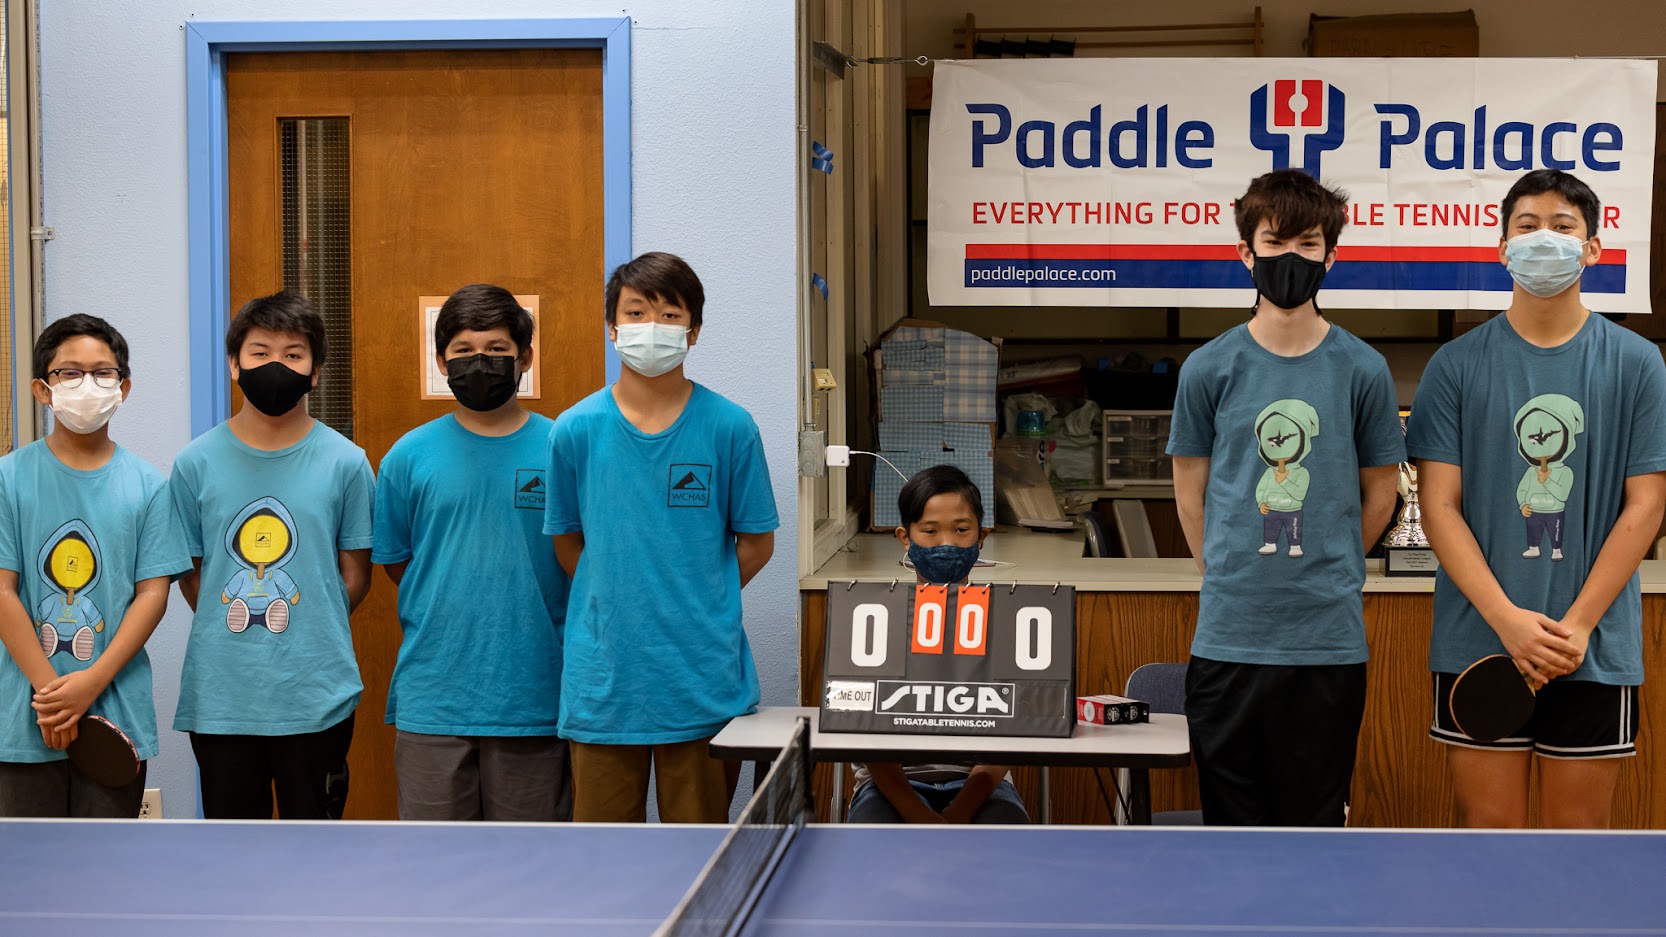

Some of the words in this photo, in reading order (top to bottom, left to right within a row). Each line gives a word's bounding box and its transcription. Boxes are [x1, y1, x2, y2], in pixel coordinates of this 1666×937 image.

[965, 103, 1215, 169] Paddle
[1374, 103, 1624, 171] Palace
[973, 202, 1153, 225] EVERYTHING
[1164, 202, 1221, 225] FOR
[1394, 204, 1499, 228] TENNIS
[971, 266, 1116, 283] paddlepalace.com
[518, 495, 546, 503] WCHA
[671, 493, 706, 501] WCHAS
[850, 603, 889, 667] 0
[917, 602, 942, 648] 0
[958, 603, 984, 649] 0
[1015, 606, 1052, 671] 0
[833, 690, 853, 701] IME
[854, 690, 872, 702] OUT
[881, 685, 1008, 714] STIGA
[893, 717, 996, 728] STIGATABLETENNIS.COM
